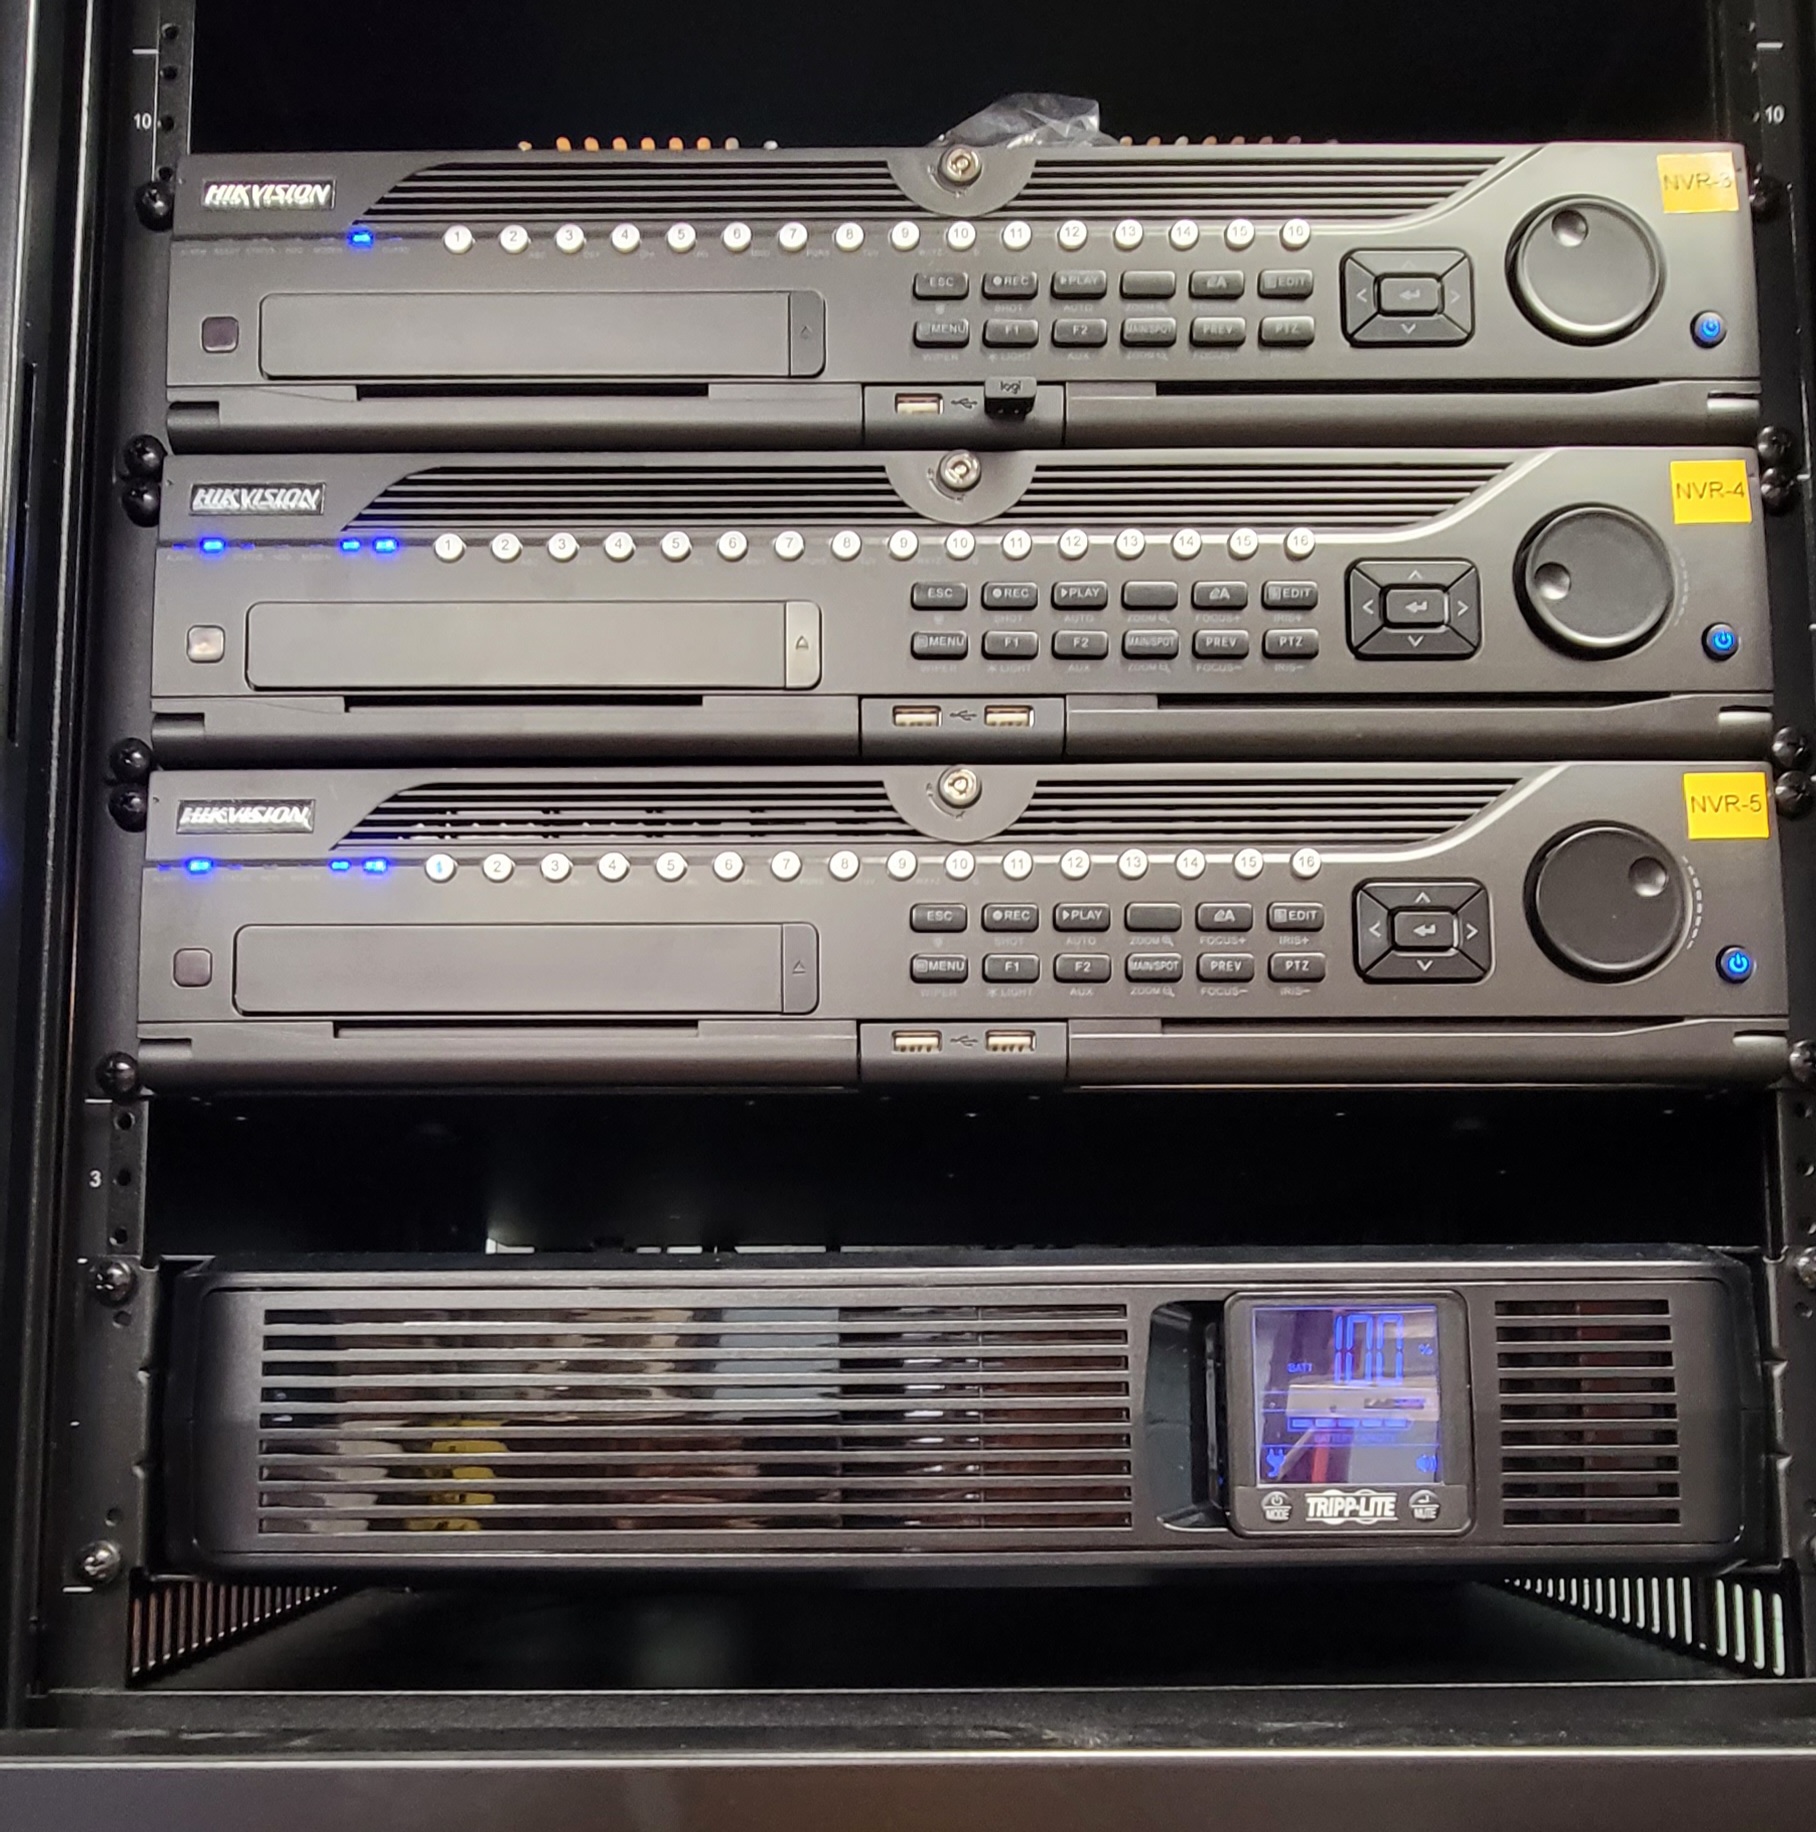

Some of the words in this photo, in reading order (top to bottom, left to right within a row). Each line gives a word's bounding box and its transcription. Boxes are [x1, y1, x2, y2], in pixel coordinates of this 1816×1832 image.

[1765, 105, 1785, 124] 10
[134, 113, 151, 130] 10
[205, 184, 331, 208] HIKVISION
[454, 230, 460, 243] 1
[508, 229, 518, 243] 2
[565, 228, 574, 242] 3
[621, 228, 629, 240] 4
[677, 227, 686, 241] 5
[732, 227, 742, 240] 6
[789, 227, 798, 240] 7
[845, 227, 854, 241] 8
[901, 226, 910, 239] 9
[953, 227, 969, 239] 10
[1009, 227, 1023, 239] 11
[1064, 225, 1080, 238] 12
[1121, 225, 1136, 237] 13
[1176, 225, 1191, 238] 14
[1232, 225, 1248, 237] 15
[930, 277, 954, 286] ESC
[1004, 276, 1029, 285] REC
[1068, 276, 1098, 284] PLAY
[1278, 277, 1306, 287] EDIT
[931, 321, 965, 333] MENU
[1005, 325, 1019, 335] F1
[1073, 325, 1088, 335] F2
[1203, 325, 1233, 334] PREV
[1275, 324, 1299, 333] PTZ
[1000, 380, 1021, 395] logi
[1677, 482, 1745, 500] NVR-4
[192, 487, 320, 511] HIKVISION
[444, 539, 451, 551] 1
[501, 538, 510, 551] 2
[557, 537, 567, 551] 3
[614, 537, 623, 550] 4
[671, 537, 681, 550] 5
[728, 536, 737, 550] 6
[784, 536, 794, 549] 7
[842, 536, 852, 549] 8
[899, 536, 909, 549] 9
[952, 537, 968, 549] 10
[1009, 536, 1023, 549] 11
[1065, 535, 1082, 547] 12
[1122, 535, 1139, 548] 13
[1178, 535, 1194, 547] 14
[1236, 535, 1252, 547] 15
[1293, 534, 1309, 547] 16
[928, 588, 953, 598] ESC
[1004, 588, 1029, 598] REC
[1069, 588, 1100, 598] PLAY
[1282, 588, 1312, 598] EDIT
[1064, 615, 1094, 623] AUTO
[929, 637, 965, 647] MENU
[1005, 637, 1019, 647] F1
[1073, 637, 1089, 648] F2
[1206, 637, 1237, 647] PREV
[1279, 636, 1303, 646] PTZ
[1691, 794, 1761, 813] NVR-5
[179, 806, 309, 826] HIKVISION
[435, 860, 443, 874] 1
[493, 860, 502, 874] 2
[551, 859, 560, 873] 3
[608, 859, 617, 871] 4
[666, 858, 676, 872] 5
[724, 858, 734, 872] 6
[782, 857, 791, 871] 7
[840, 857, 849, 870] 8
[898, 857, 907, 870] 9
[951, 857, 969, 870] 10
[1010, 857, 1024, 870] 11
[1067, 855, 1084, 869] 12
[1125, 855, 1142, 869] 13
[1182, 856, 1199, 868] 14
[1240, 855, 1257, 869] 15
[1298, 855, 1315, 868] 16
[927, 910, 952, 921] ESC
[1004, 910, 1030, 921] REC
[1071, 910, 1102, 920] PLAY
[1288, 910, 1317, 921] EDIT
[1066, 937, 1096, 945] AUTO
[1129, 937, 1160, 946] ZOOM
[1200, 936, 1247, 945] FOCUS+
[1279, 936, 1309, 945] IRIS+
[928, 961, 965, 971] MENU
[1005, 962, 1020, 972] F1
[1074, 961, 1091, 972] F2
[1211, 961, 1242, 971] PREV
[1285, 960, 1309, 971] PTZ
[1070, 987, 1094, 996] AUX
[1130, 987, 1161, 996] ZOOM
[89, 1170, 102, 1188] 3
[1334, 1313, 1404, 1386] 100
[1287, 1362, 1313, 1374] BATT
